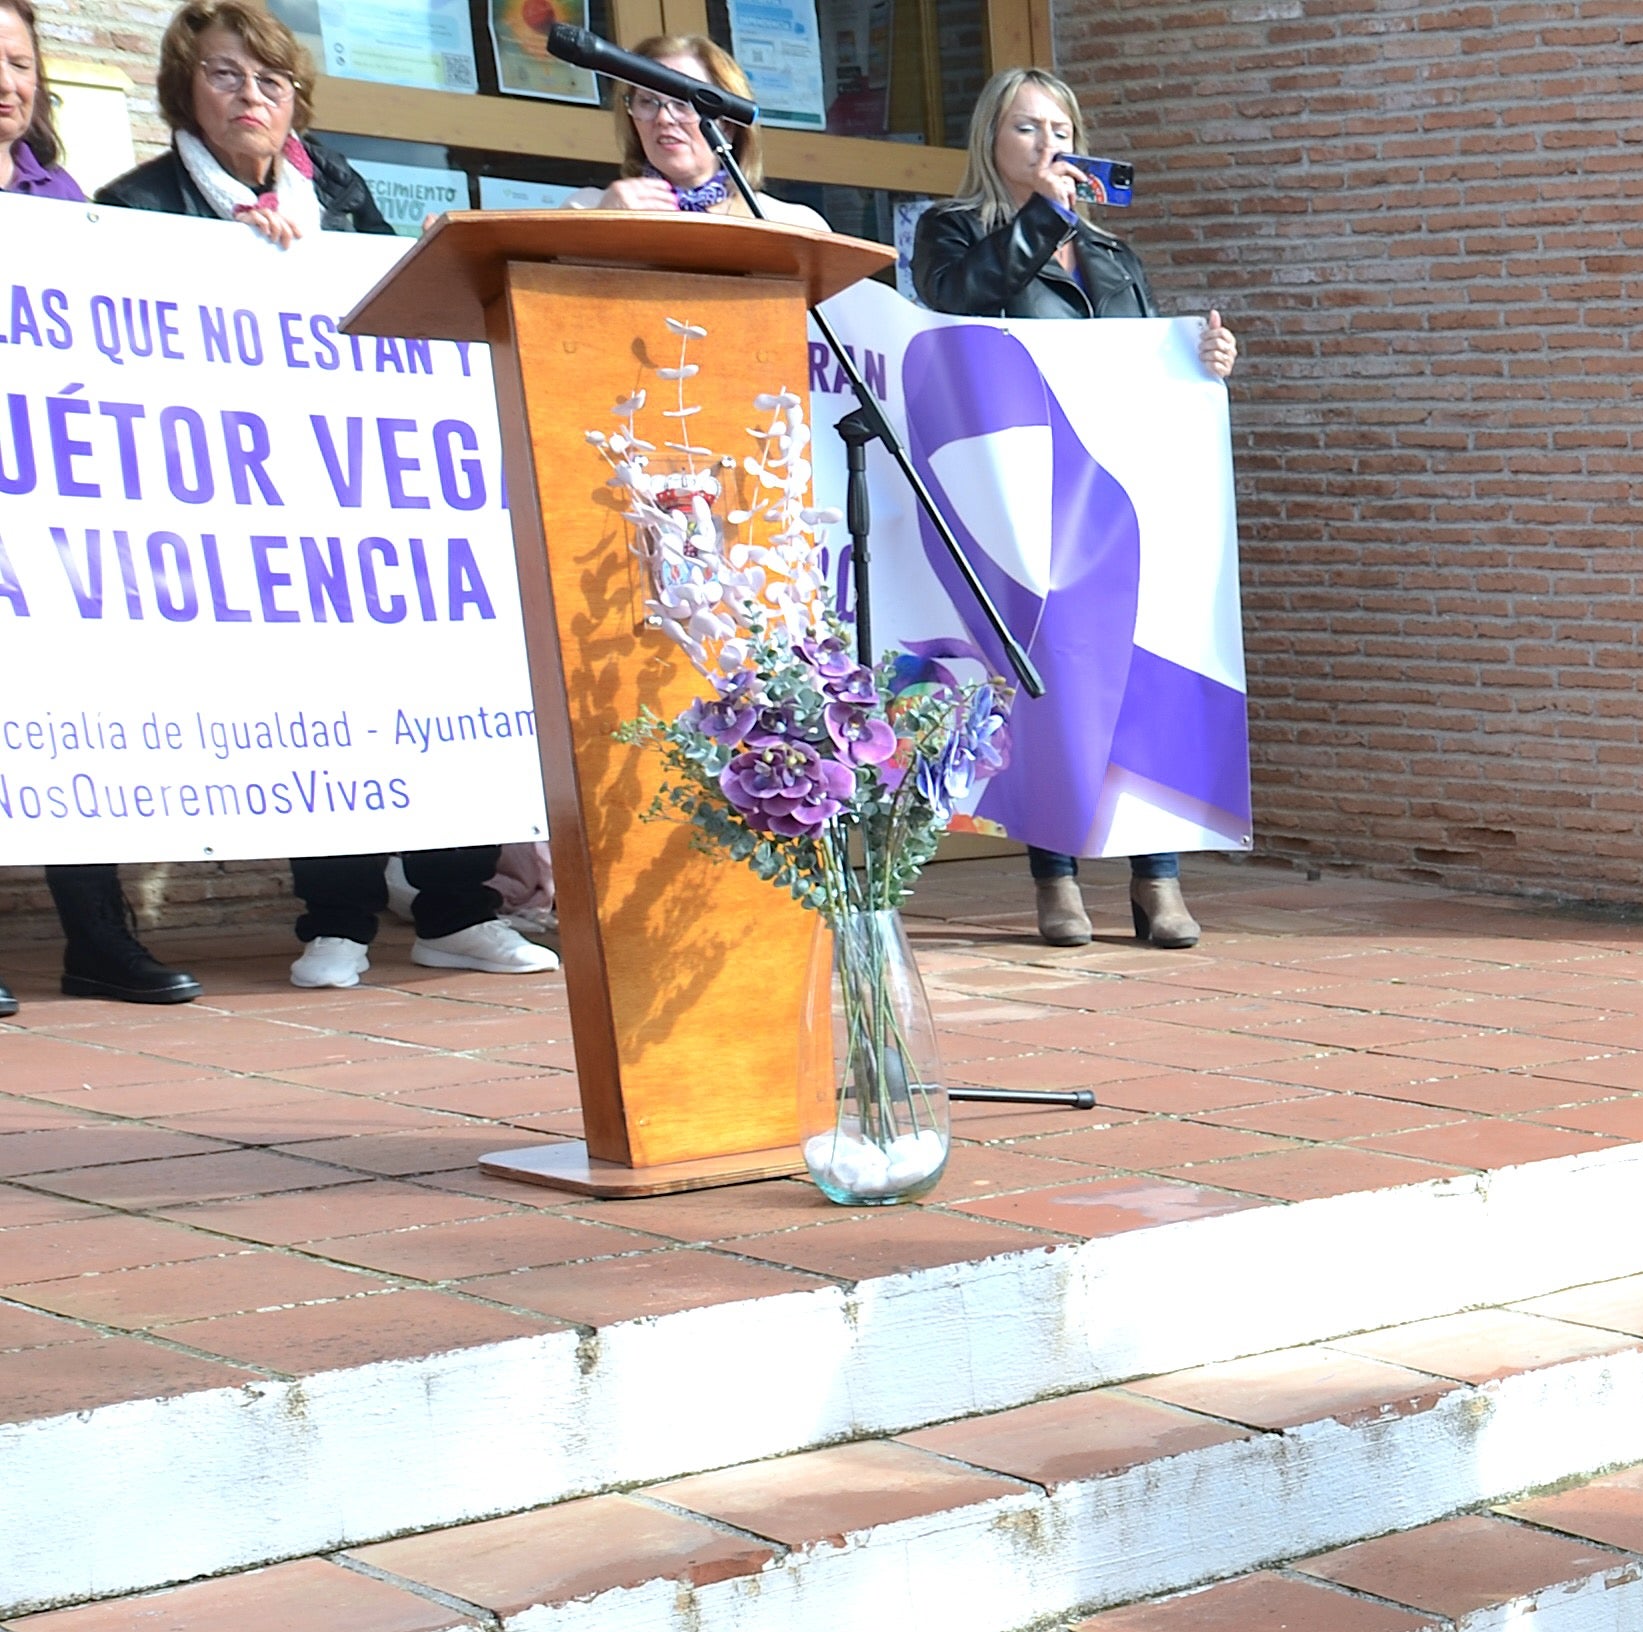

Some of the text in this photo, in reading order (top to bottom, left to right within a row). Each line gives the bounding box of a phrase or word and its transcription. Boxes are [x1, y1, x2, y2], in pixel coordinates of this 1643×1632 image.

[0, 284, 74, 351] AS
[89, 294, 186, 366] QUE
[197, 304, 265, 367] NO
[308, 413, 509, 511] VEG
[48, 526, 497, 625] VIOLENCIA
[142, 711, 184, 751] de
[196, 709, 352, 760] Igualdad
